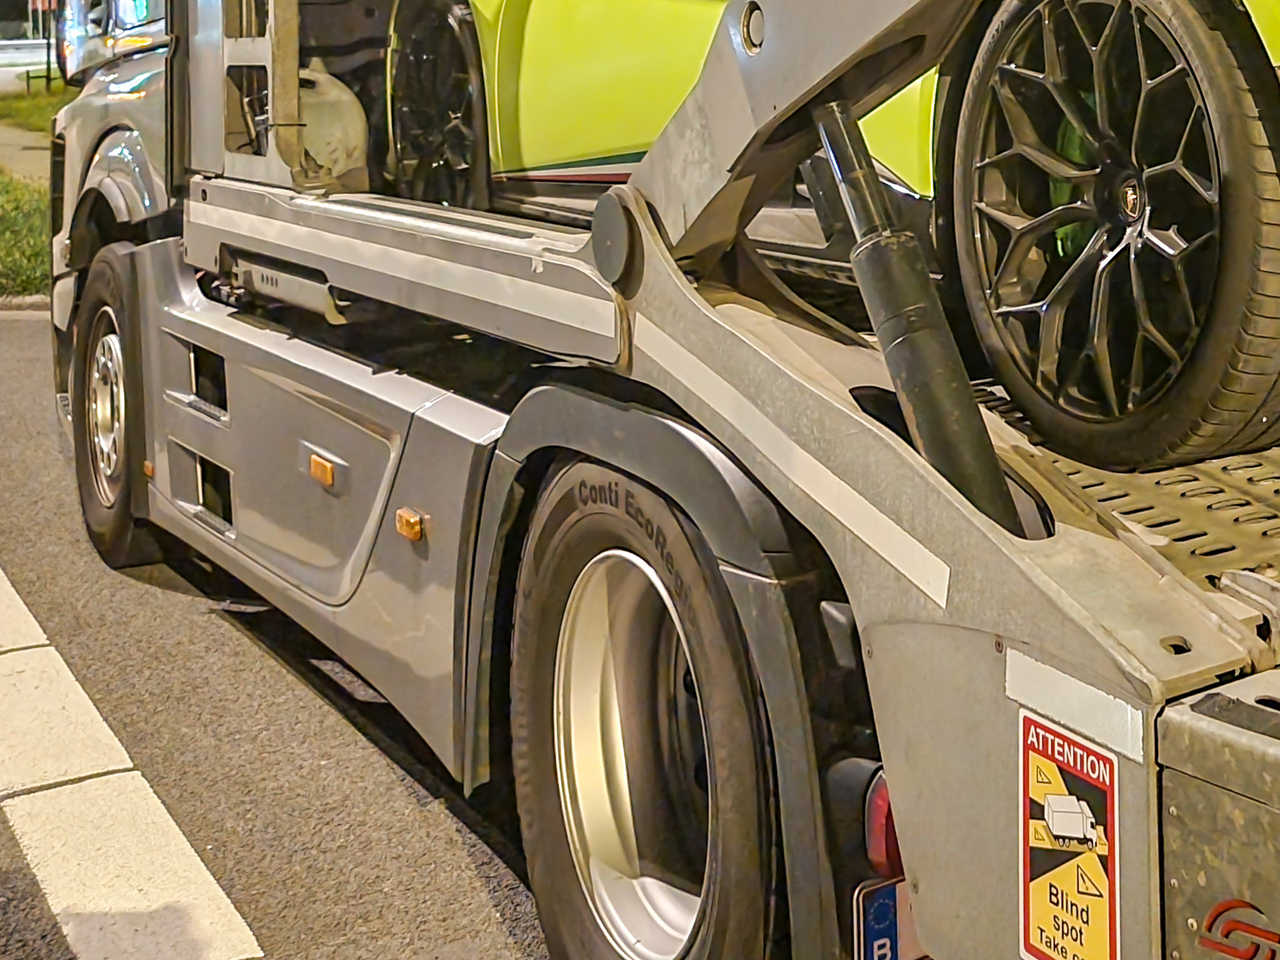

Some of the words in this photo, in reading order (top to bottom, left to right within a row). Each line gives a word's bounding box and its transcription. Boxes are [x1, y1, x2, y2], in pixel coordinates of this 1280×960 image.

[578, 479, 619, 509] Conti
[1027, 725, 1110, 786] ATTENTION
[1049, 882, 1090, 926] Blind
[1037, 925, 1068, 959] Take
[1053, 914, 1084, 947] spot
[873, 938, 892, 960] B
